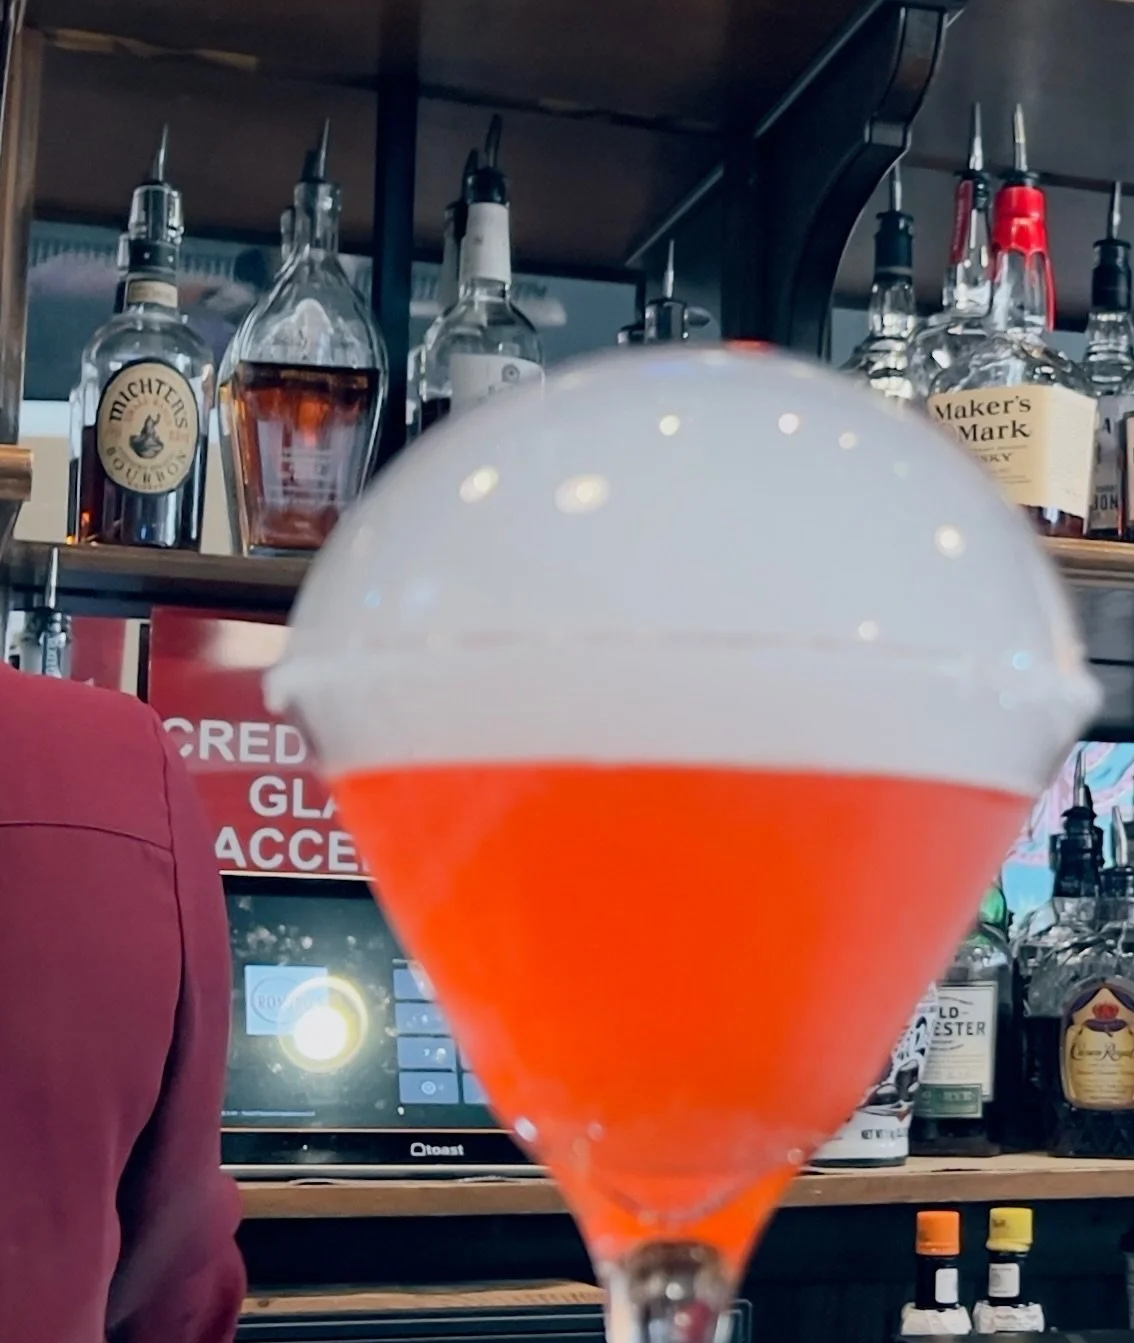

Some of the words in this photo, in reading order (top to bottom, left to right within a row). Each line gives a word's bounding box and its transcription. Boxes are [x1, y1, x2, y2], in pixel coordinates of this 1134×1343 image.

[933, 394, 1032, 422] Maker's
[957, 419, 1032, 443] Mark
[162, 716, 309, 765] CRED
[938, 1006, 960, 1019] LD
[933, 1021, 986, 1037] ESTER
[426, 1143, 465, 1157] toast
